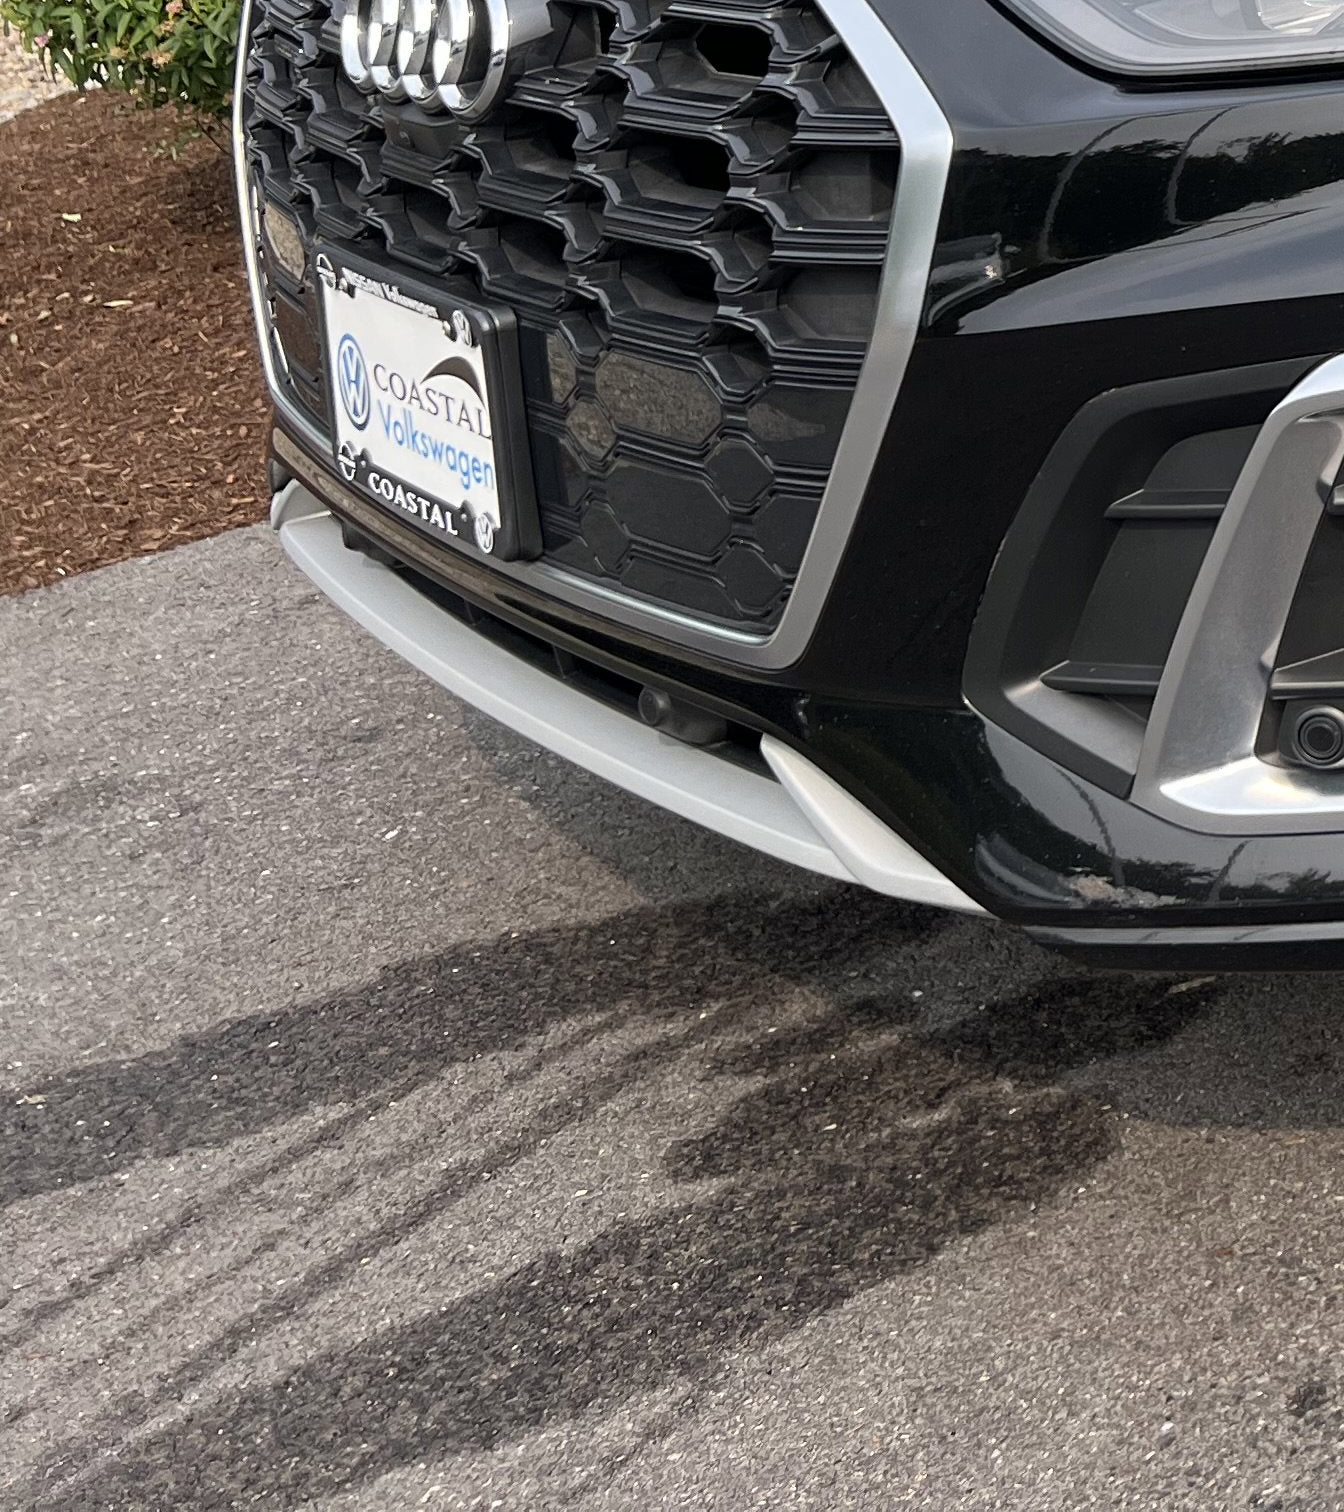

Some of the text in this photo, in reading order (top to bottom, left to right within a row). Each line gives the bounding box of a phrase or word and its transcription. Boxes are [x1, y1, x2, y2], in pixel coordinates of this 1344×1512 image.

[373, 363, 493, 439] COASTAL
[377, 399, 495, 489] Volkswagen
[367, 471, 459, 536] COASTAL
